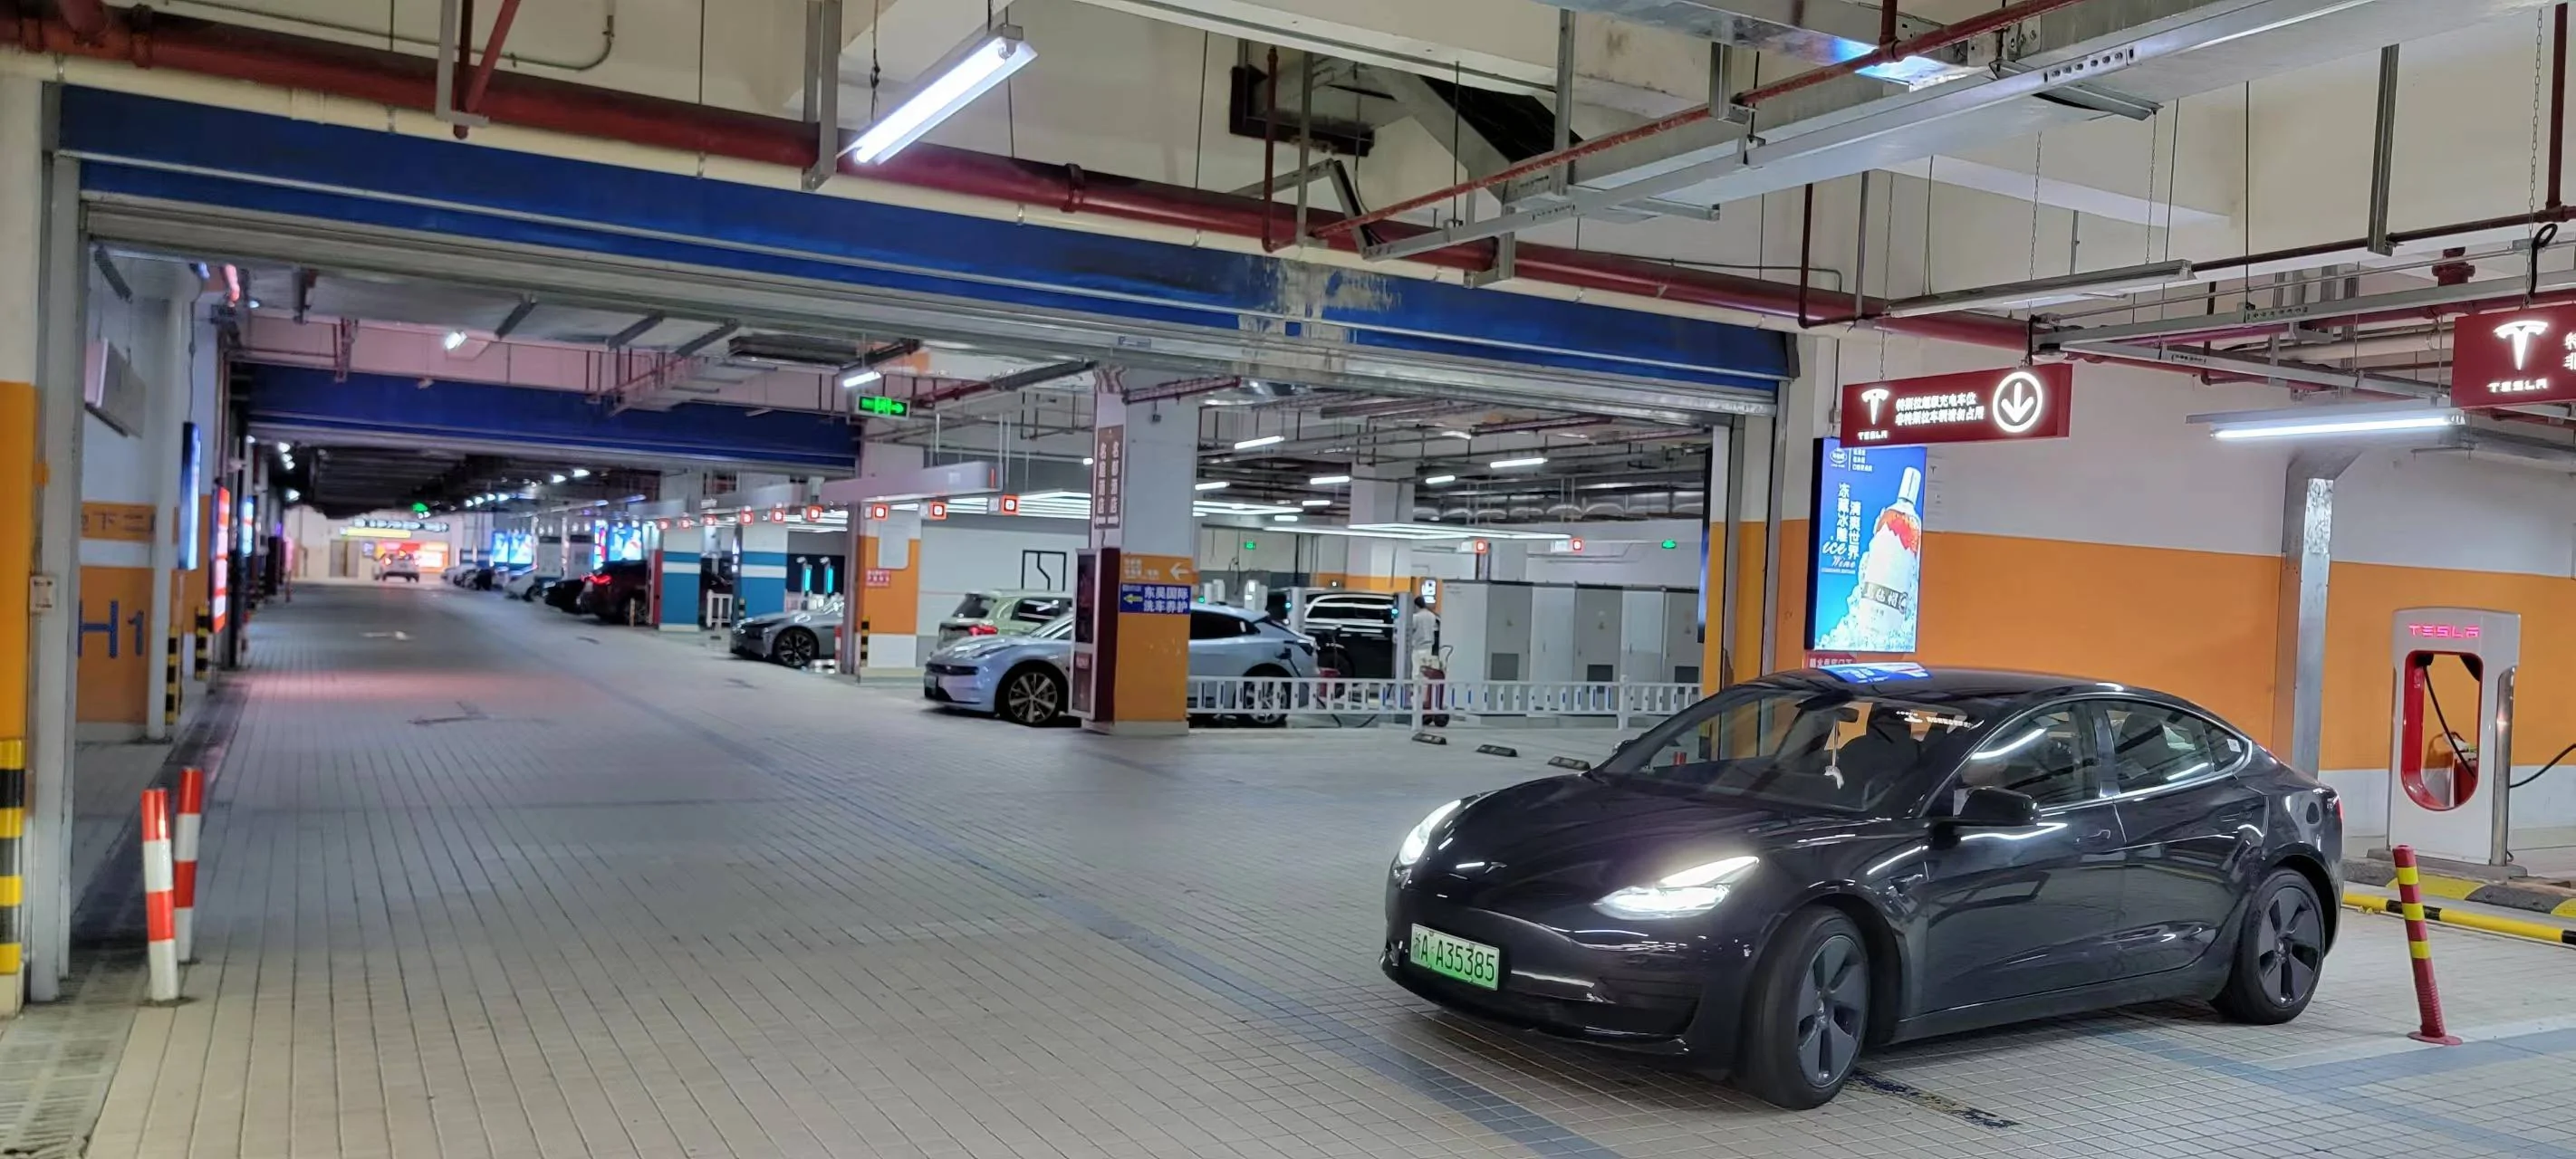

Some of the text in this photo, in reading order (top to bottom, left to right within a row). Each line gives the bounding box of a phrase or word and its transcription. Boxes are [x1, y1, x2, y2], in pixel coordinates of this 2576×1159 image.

[2486, 378, 2548, 393] TESLA
[1857, 430, 1889, 441] TESLA
[1821, 535, 1847, 555] ice
[1144, 586, 1188, 599] 东吴国际
[1143, 599, 1188, 613] 洗车养护
[2408, 625, 2480, 638] TESLA
